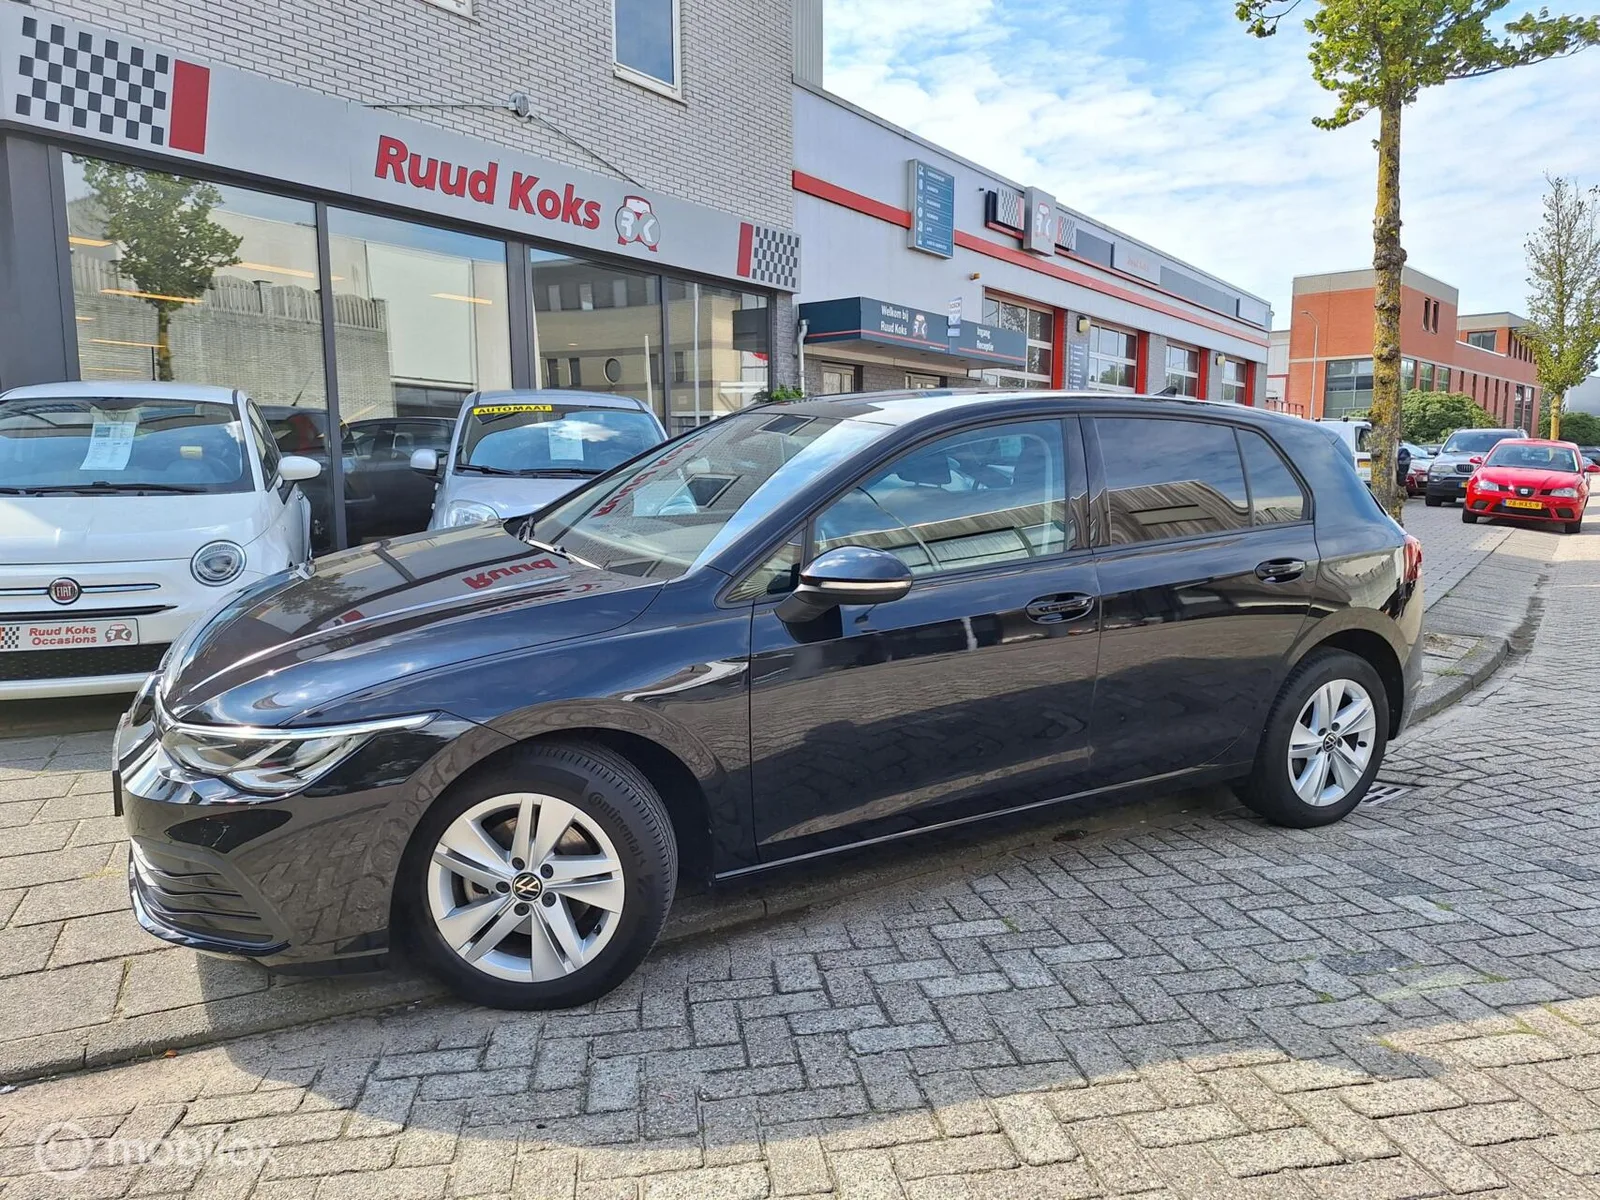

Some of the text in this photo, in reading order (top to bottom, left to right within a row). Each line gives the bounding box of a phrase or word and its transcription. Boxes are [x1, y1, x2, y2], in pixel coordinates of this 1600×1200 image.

[374, 135, 602, 230] Ruud Koks
[881, 305, 902, 320] Welkom
[880, 320, 908, 336] Ruud Koks
[477, 405, 548, 414] AUTOMAAT
[56, 586, 72, 597] FIAT
[29, 626, 97, 636] Ruud Koks
[32, 636, 98, 646] Occasions
[588, 791, 645, 857] Continental
